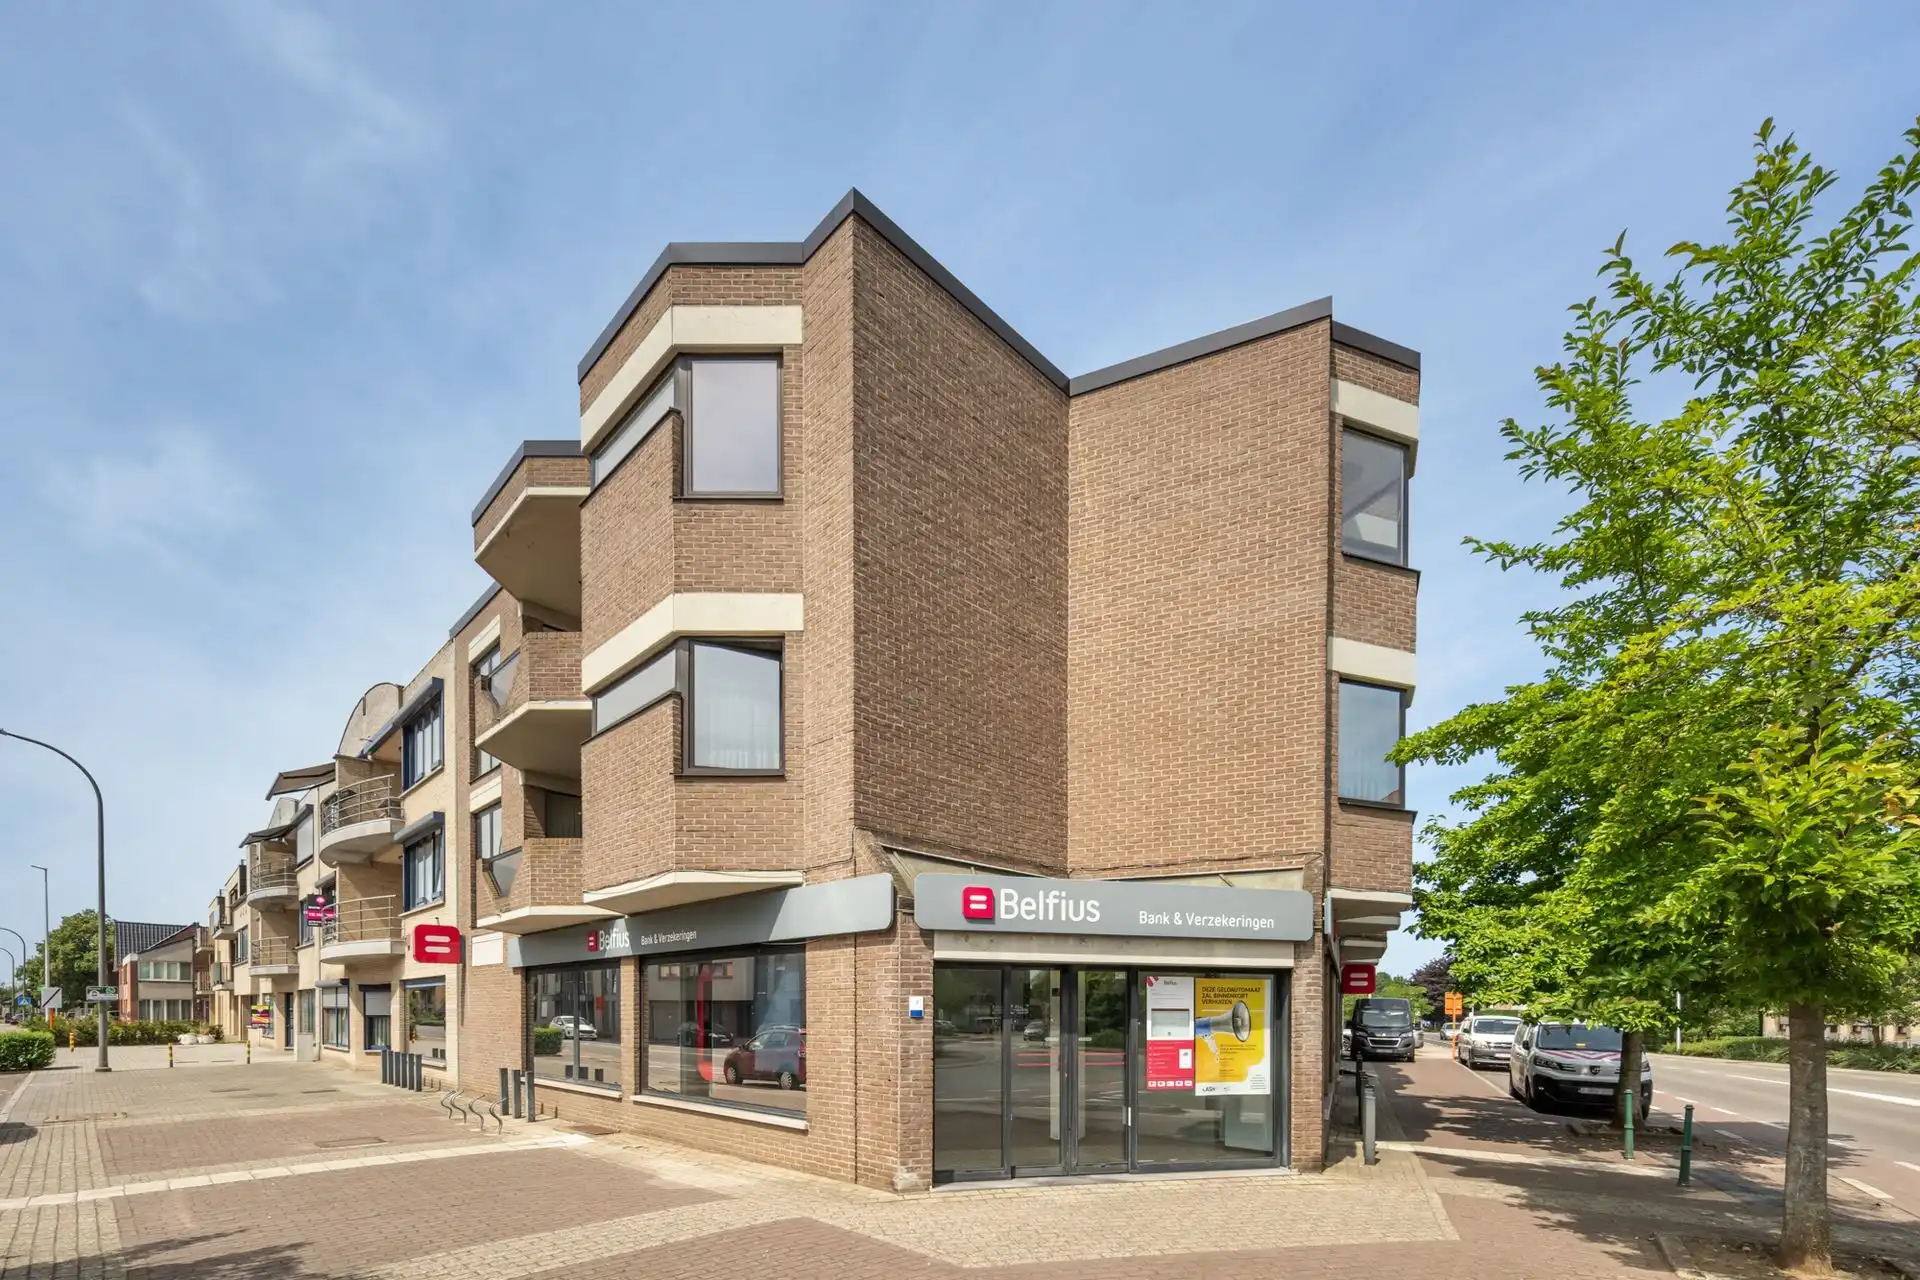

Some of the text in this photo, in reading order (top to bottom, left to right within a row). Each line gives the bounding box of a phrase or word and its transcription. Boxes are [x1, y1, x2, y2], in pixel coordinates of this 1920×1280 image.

[1000, 888, 1100, 922] Belfius
[1139, 910, 1275, 931] Bank & Verzekeringen
[599, 928, 630, 951] Belfius
[640, 935, 653, 946] Bank
[659, 931, 697, 943] Verzekeringen
